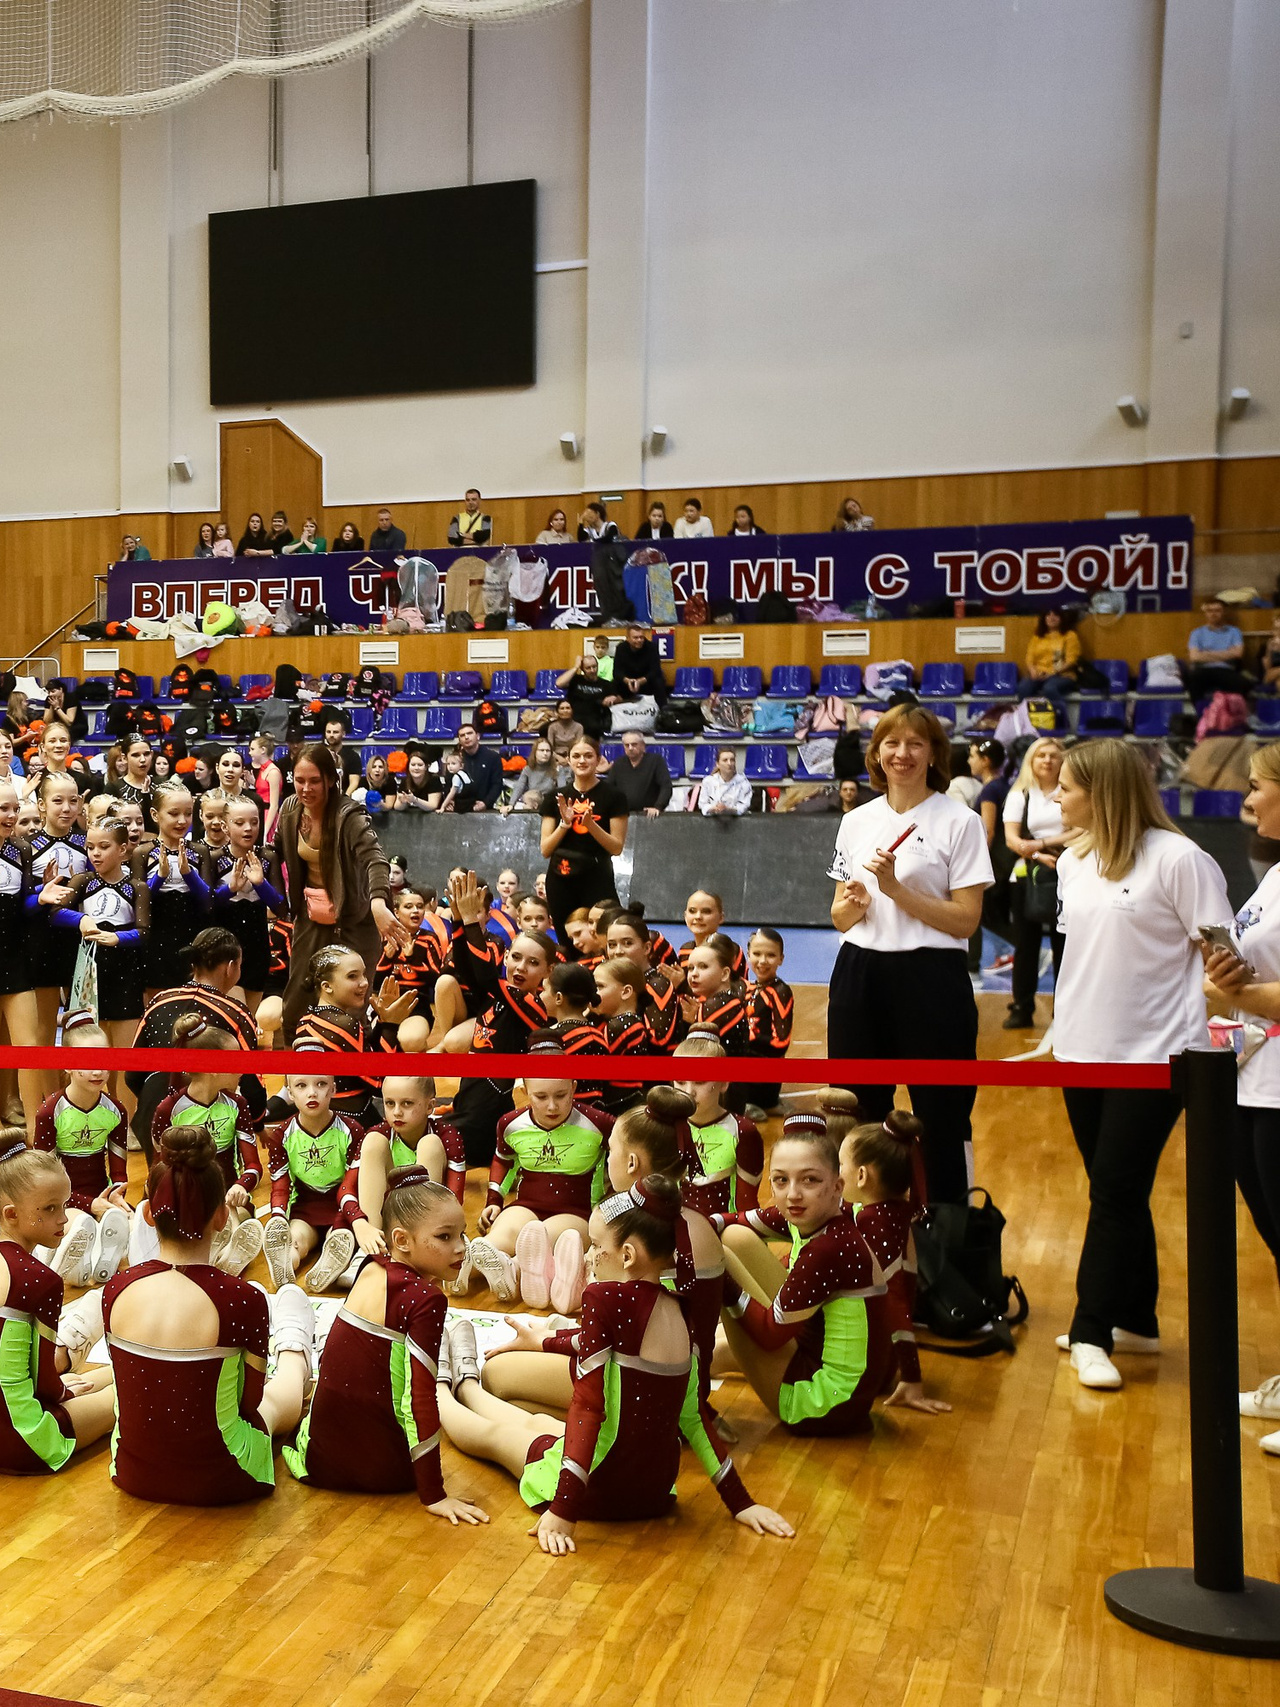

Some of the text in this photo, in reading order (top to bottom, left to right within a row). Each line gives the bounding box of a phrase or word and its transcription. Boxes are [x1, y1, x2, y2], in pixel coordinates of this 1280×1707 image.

[730, 556, 834, 602] МЫ
[865, 553, 910, 600] С
[934, 533, 1189, 597] ТОБОЙ!
